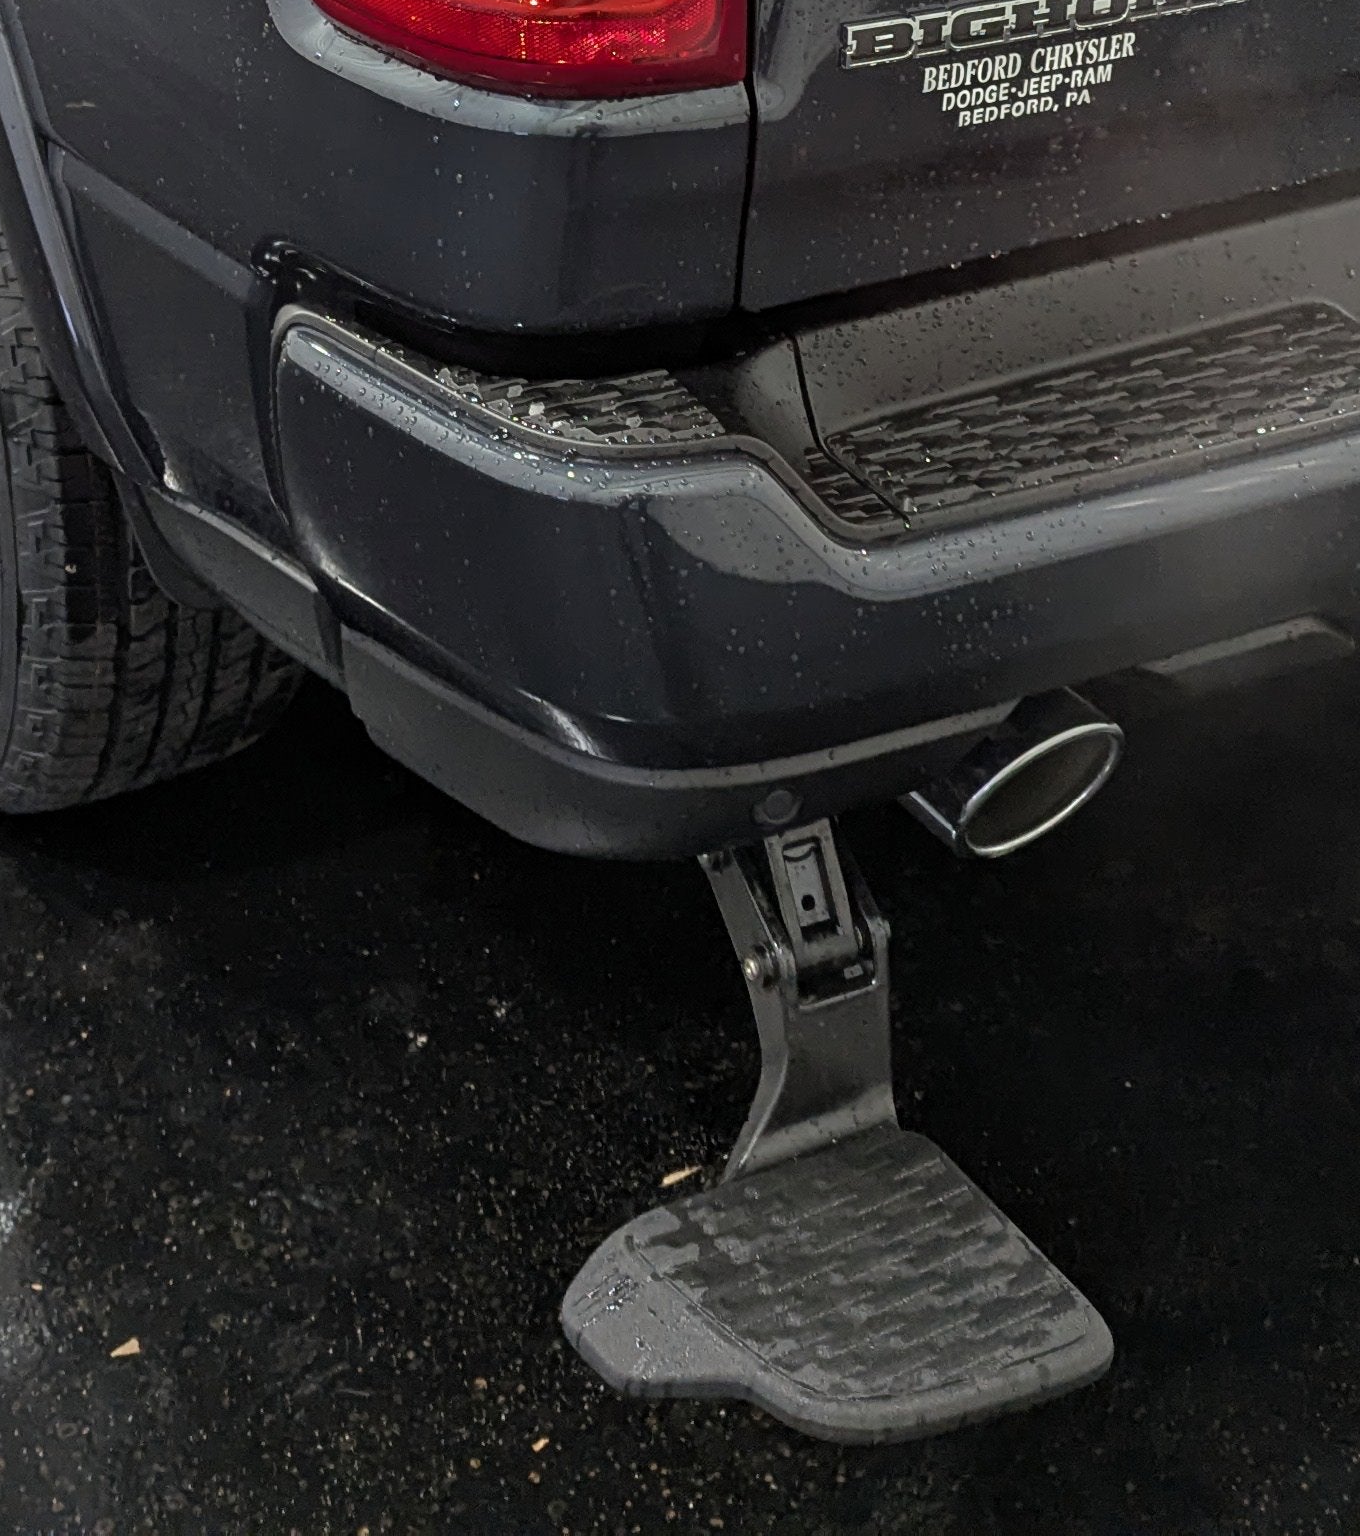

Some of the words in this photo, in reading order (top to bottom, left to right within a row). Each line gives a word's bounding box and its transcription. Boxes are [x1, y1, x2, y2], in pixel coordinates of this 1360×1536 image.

[922, 52, 1022, 93] BEDFORD
[1030, 32, 1136, 74] CHRYSLER
[958, 95, 1060, 128] BEDFORD,
[1065, 89, 1091, 107] PA
